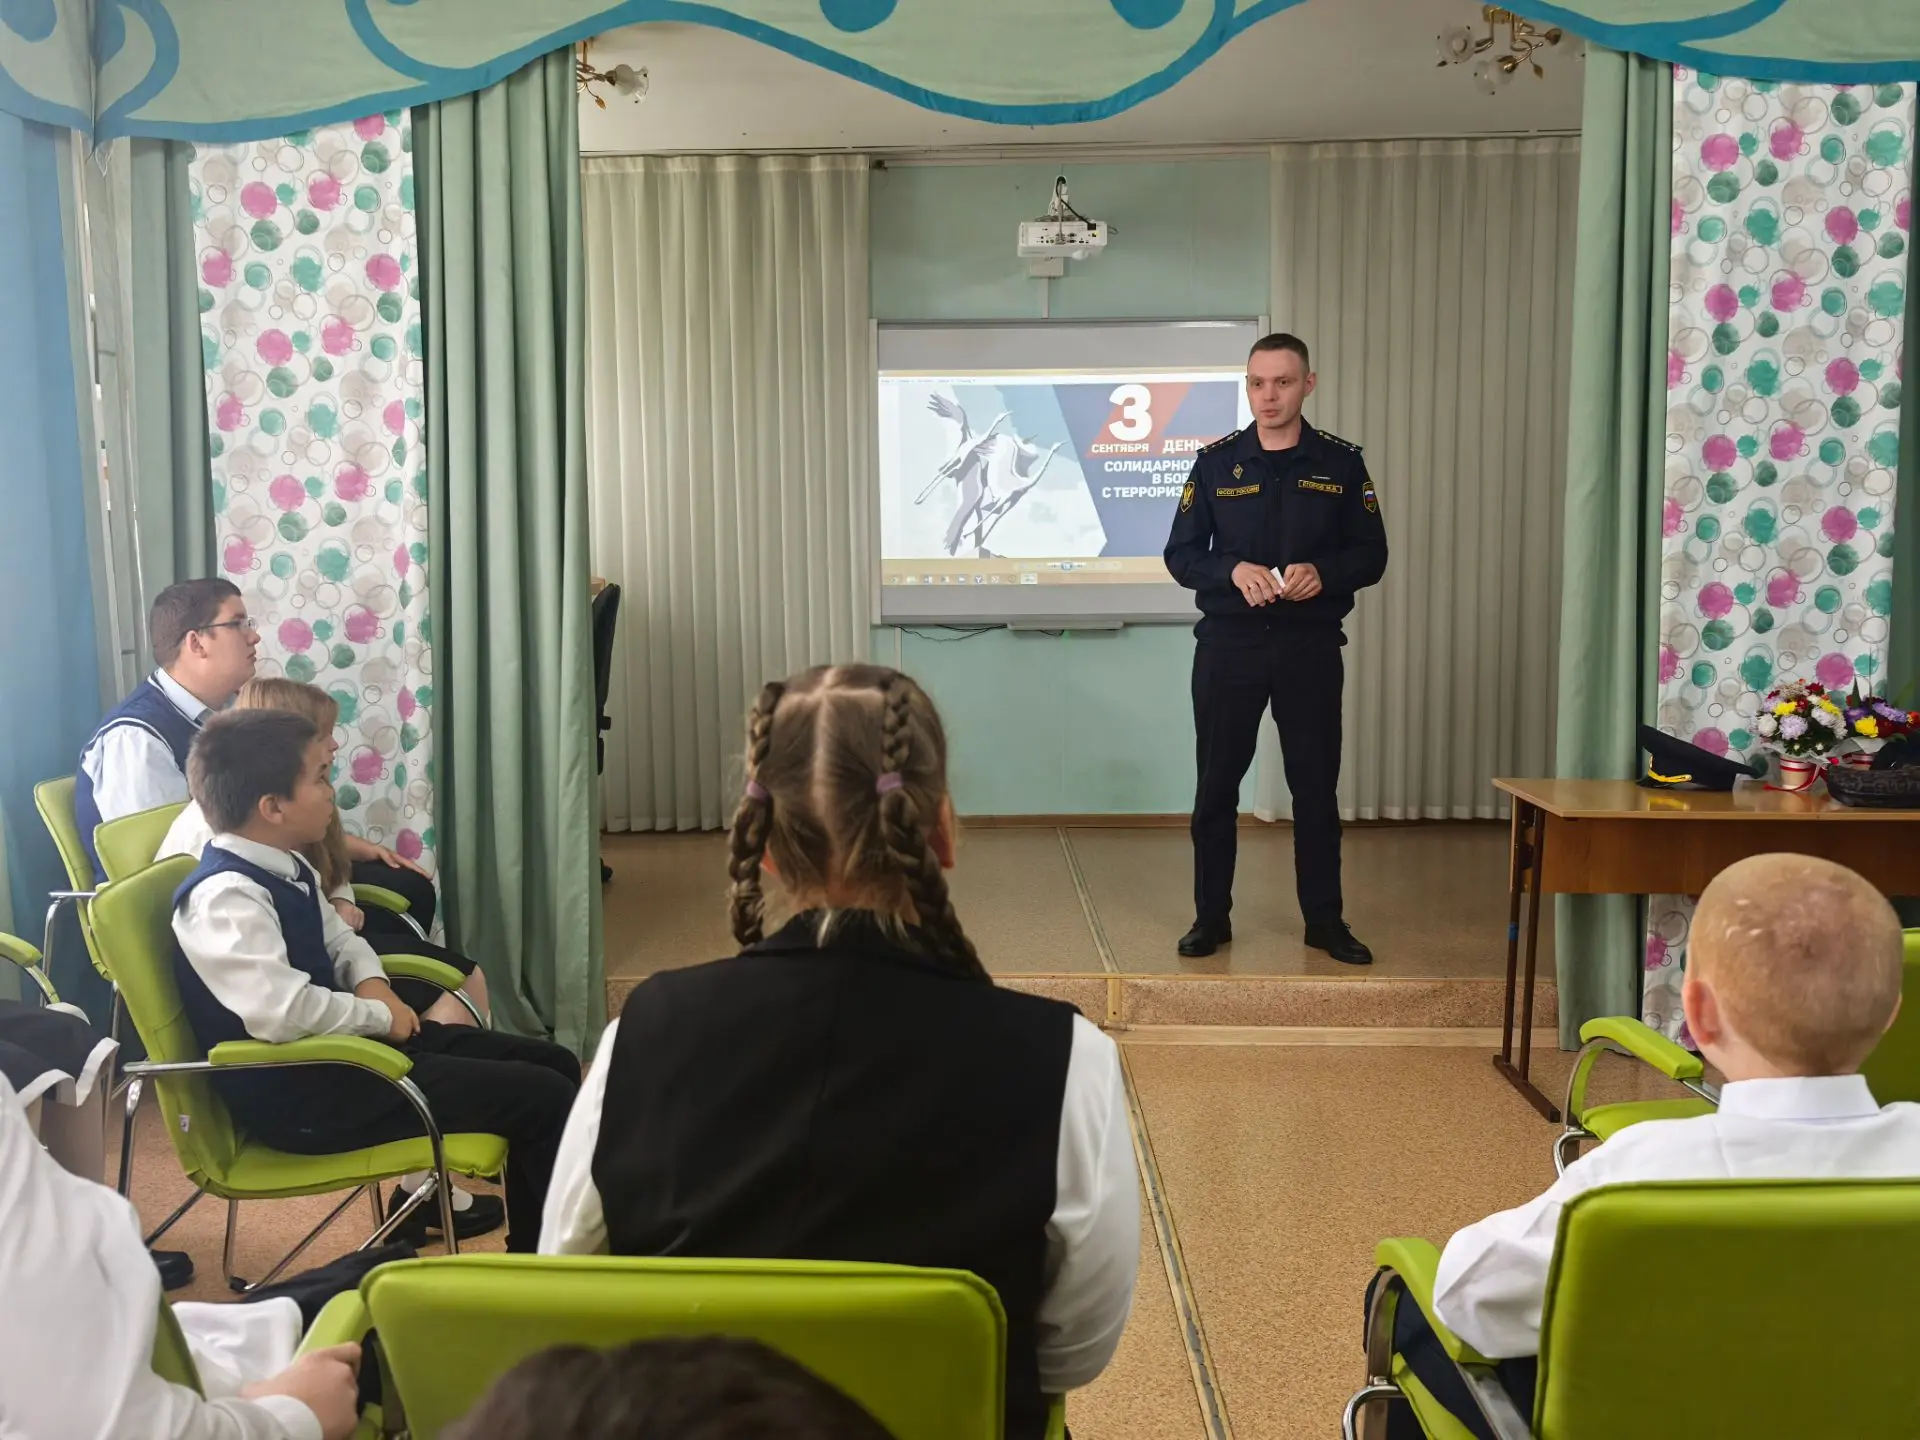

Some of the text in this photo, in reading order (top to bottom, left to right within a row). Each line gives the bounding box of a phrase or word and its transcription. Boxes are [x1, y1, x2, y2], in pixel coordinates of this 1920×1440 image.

[1108, 383, 1153, 442] 3
[1091, 442, 1150, 454] СЕНТЯБРЯ
[1162, 439, 1205, 454] ДЕНЬ
[1152, 472, 1162, 485] В
[1102, 486, 1111, 498] С
